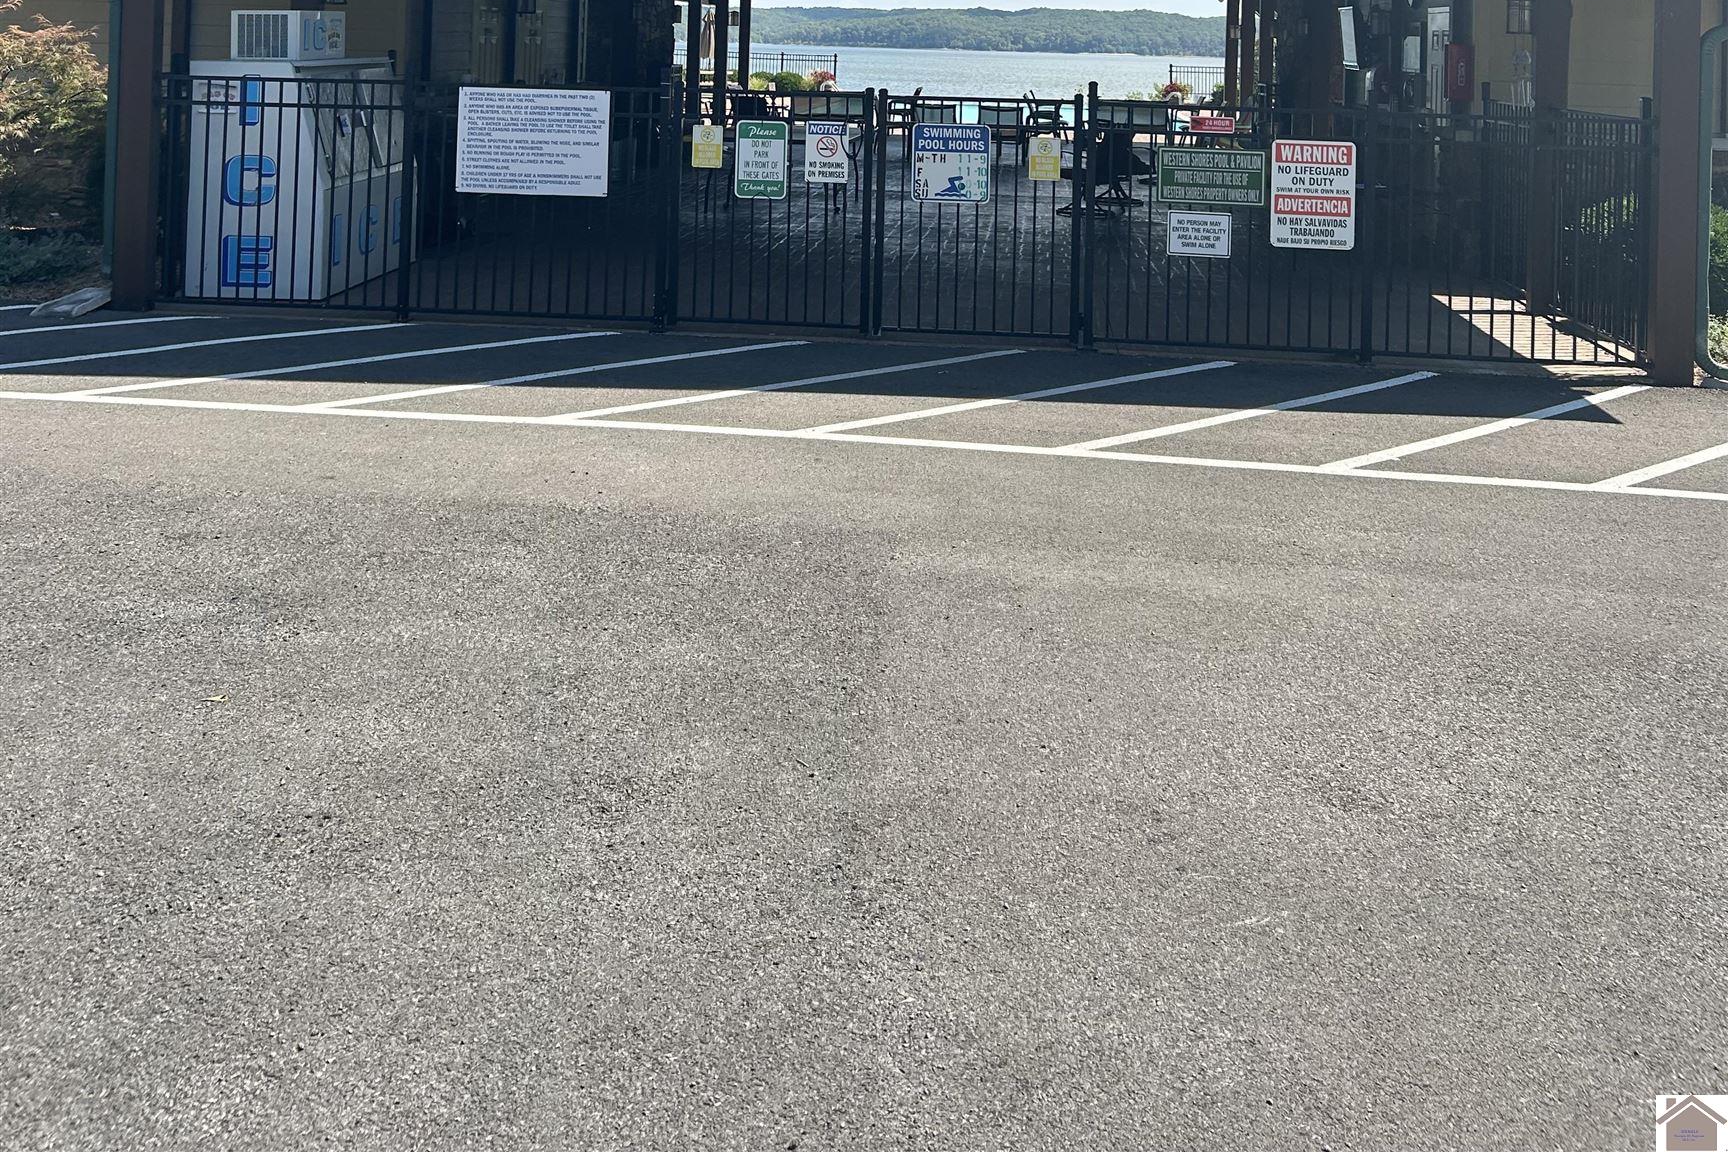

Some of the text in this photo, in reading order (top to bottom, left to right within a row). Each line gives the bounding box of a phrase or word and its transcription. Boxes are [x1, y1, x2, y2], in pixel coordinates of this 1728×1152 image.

[748, 126, 777, 137] Please
[810, 125, 846, 135] NOTICE
[923, 128, 981, 138] SWIMMING
[752, 140, 759, 148] DO
[919, 140, 985, 151] POOL HOURS
[1280, 145, 1348, 164] WARNING
[819, 161, 844, 169] SMOKING
[1163, 152, 1261, 169] WESTERN SHORES POOL & PAVILION
[917, 168, 922, 177] F
[1278, 165, 1349, 176] NO LIFEGUARD
[915, 179, 928, 188] SA
[1174, 170, 1248, 186] PRIVATE FACILITY FOR THE USE OF
[1292, 177, 1334, 186] ON DUTY
[1163, 186, 1259, 202] WESTERN SHORES PROPERTY OWNERS ONLY
[1277, 198, 1348, 213] ADVERTENCIA
[1277, 217, 1348, 228] NO HAY SALVAVIDAS
[1290, 227, 1335, 238] TRABAJANDO
